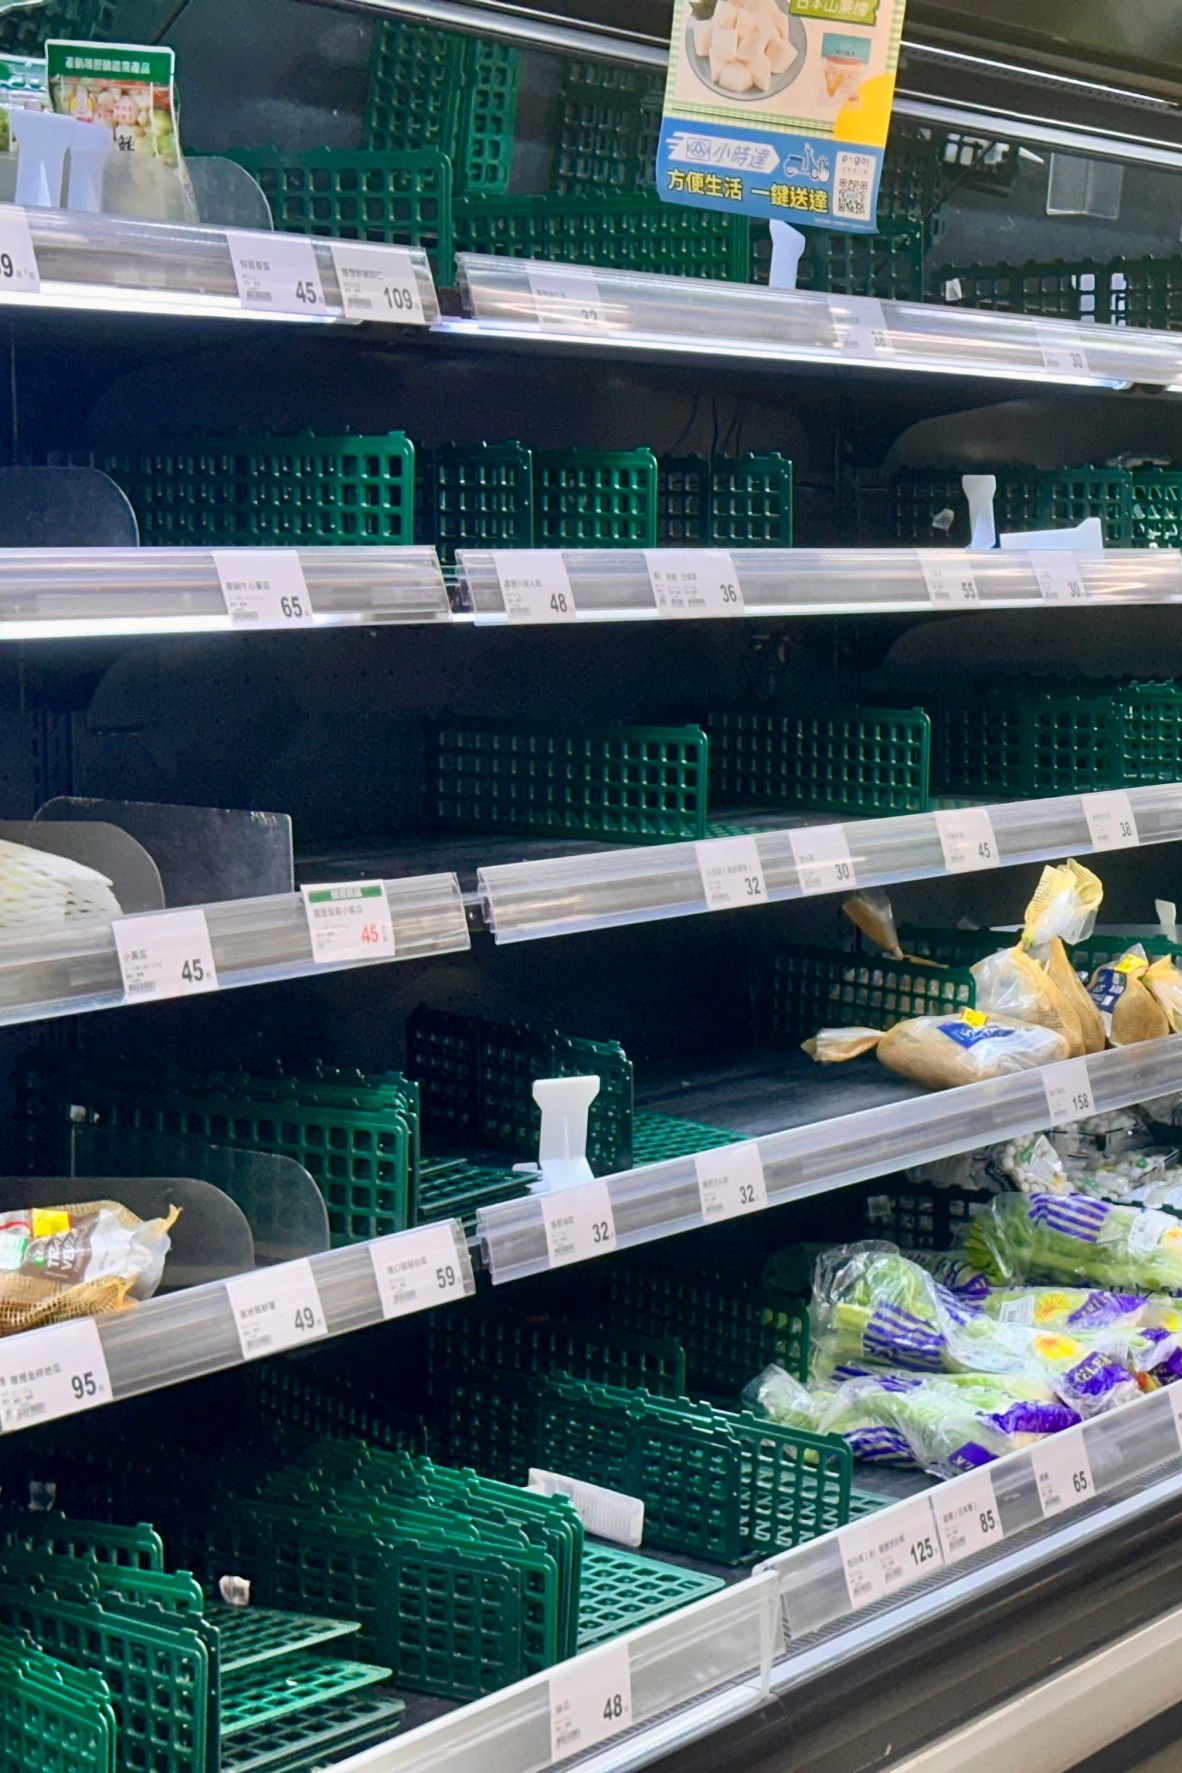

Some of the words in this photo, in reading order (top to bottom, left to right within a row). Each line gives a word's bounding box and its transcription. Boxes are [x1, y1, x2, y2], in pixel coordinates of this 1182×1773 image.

[713, 141, 771, 170] 小時達
[667, 169, 743, 201] 方便生活
[751, 181, 829, 214] 一鍵送達
[295, 280, 317, 304] 45
[383, 286, 413, 311] 109
[720, 584, 738, 603] 36
[961, 582, 976, 599] 55
[1067, 582, 1082, 598] 30
[280, 596, 303, 618] 65
[550, 592, 568, 613] 48
[1119, 822, 1132, 837] 38
[977, 842, 991, 858] 45
[834, 862, 850, 880] 30
[744, 876, 762, 896] 32
[360, 923, 380, 943] 45
[180, 958, 205, 983] 45
[1072, 1093, 1090, 1111] 158
[739, 1184, 756, 1204] 32
[592, 1221, 610, 1244] 32
[435, 1265, 456, 1289] 59
[294, 1306, 315, 1331] 49
[71, 1371, 97, 1400] 95
[1072, 1470, 1088, 1493] 65
[979, 1509, 996, 1533] 85
[910, 1536, 934, 1566] 125
[603, 1693, 623, 1721] 48
